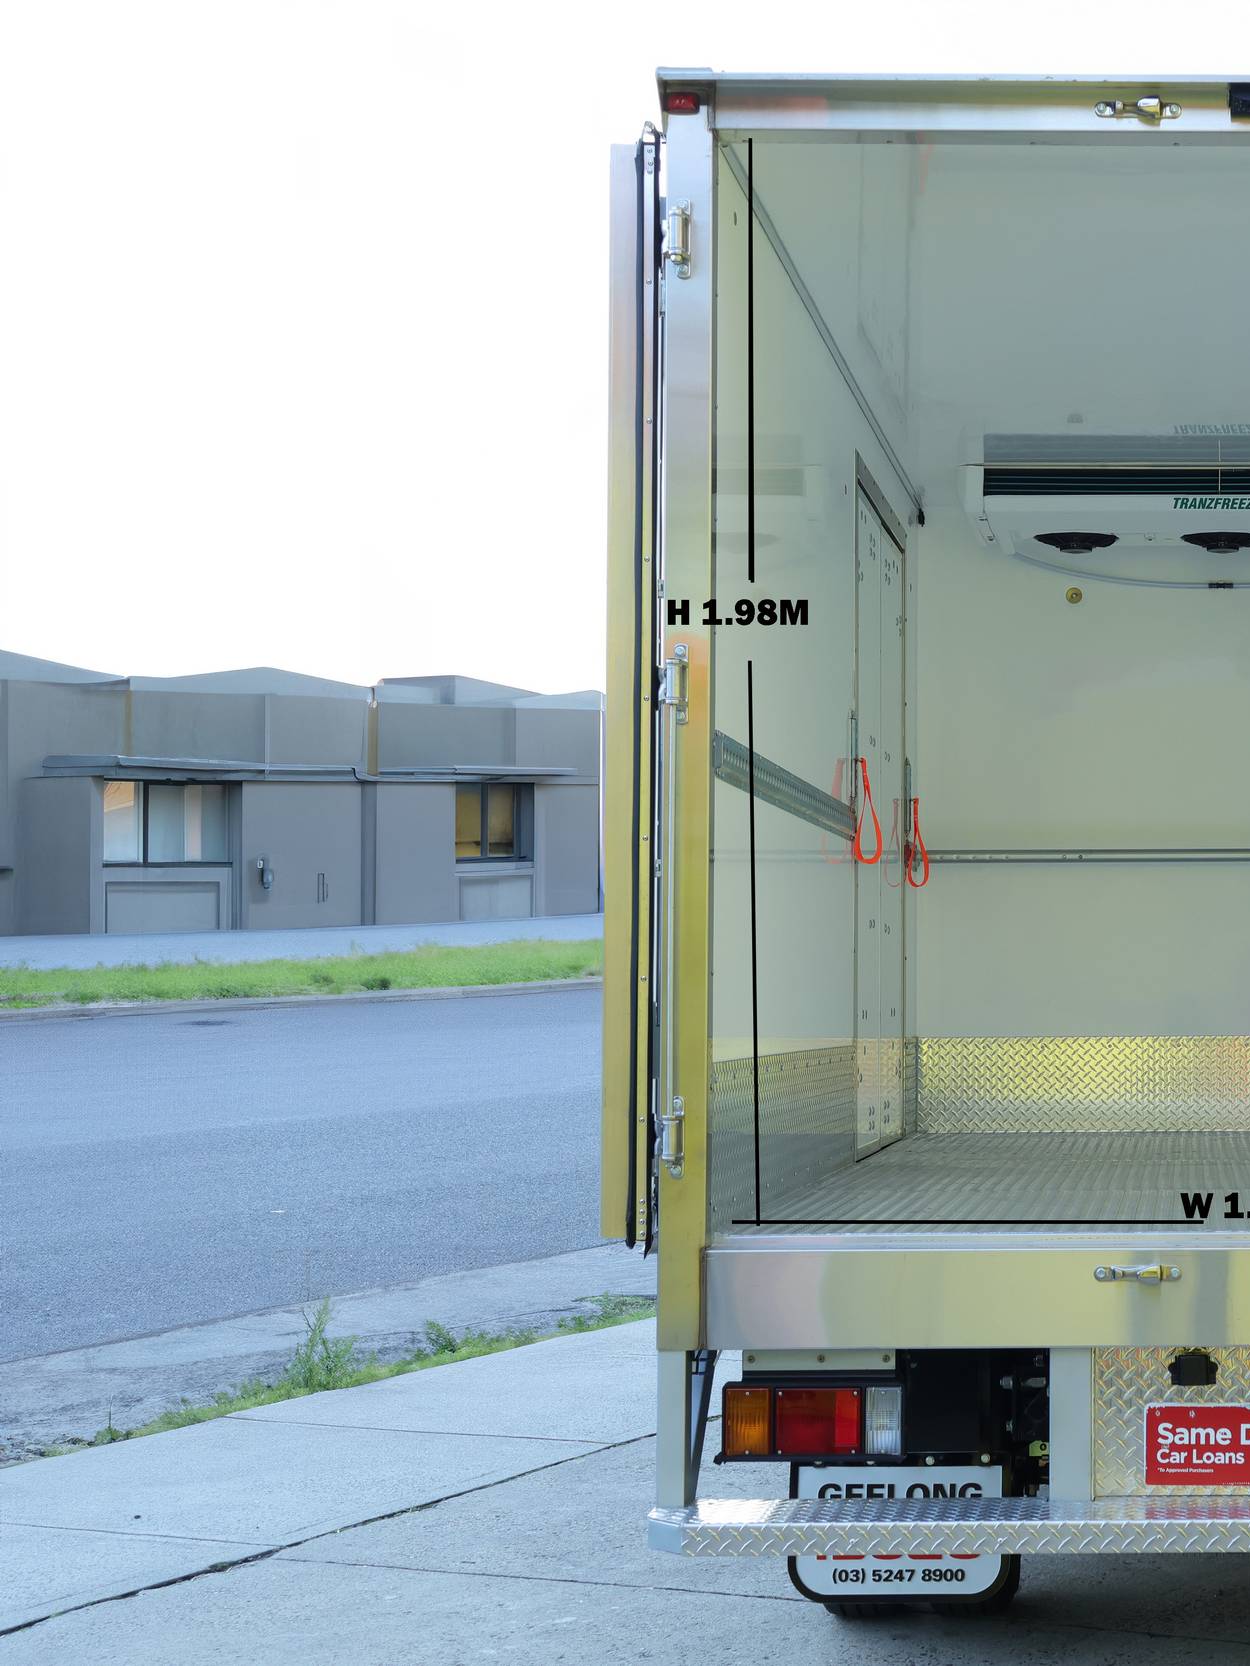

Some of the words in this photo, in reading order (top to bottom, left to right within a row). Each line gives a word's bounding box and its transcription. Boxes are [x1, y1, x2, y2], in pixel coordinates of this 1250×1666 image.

[1157, 1422, 1232, 1446] Same
[1156, 1449, 1188, 1464] Car
[1192, 1449, 1245, 1464] Loans
[832, 1568, 866, 1584] (03)
[872, 1568, 915, 1582] 5247
[921, 1568, 965, 1582] 8900
